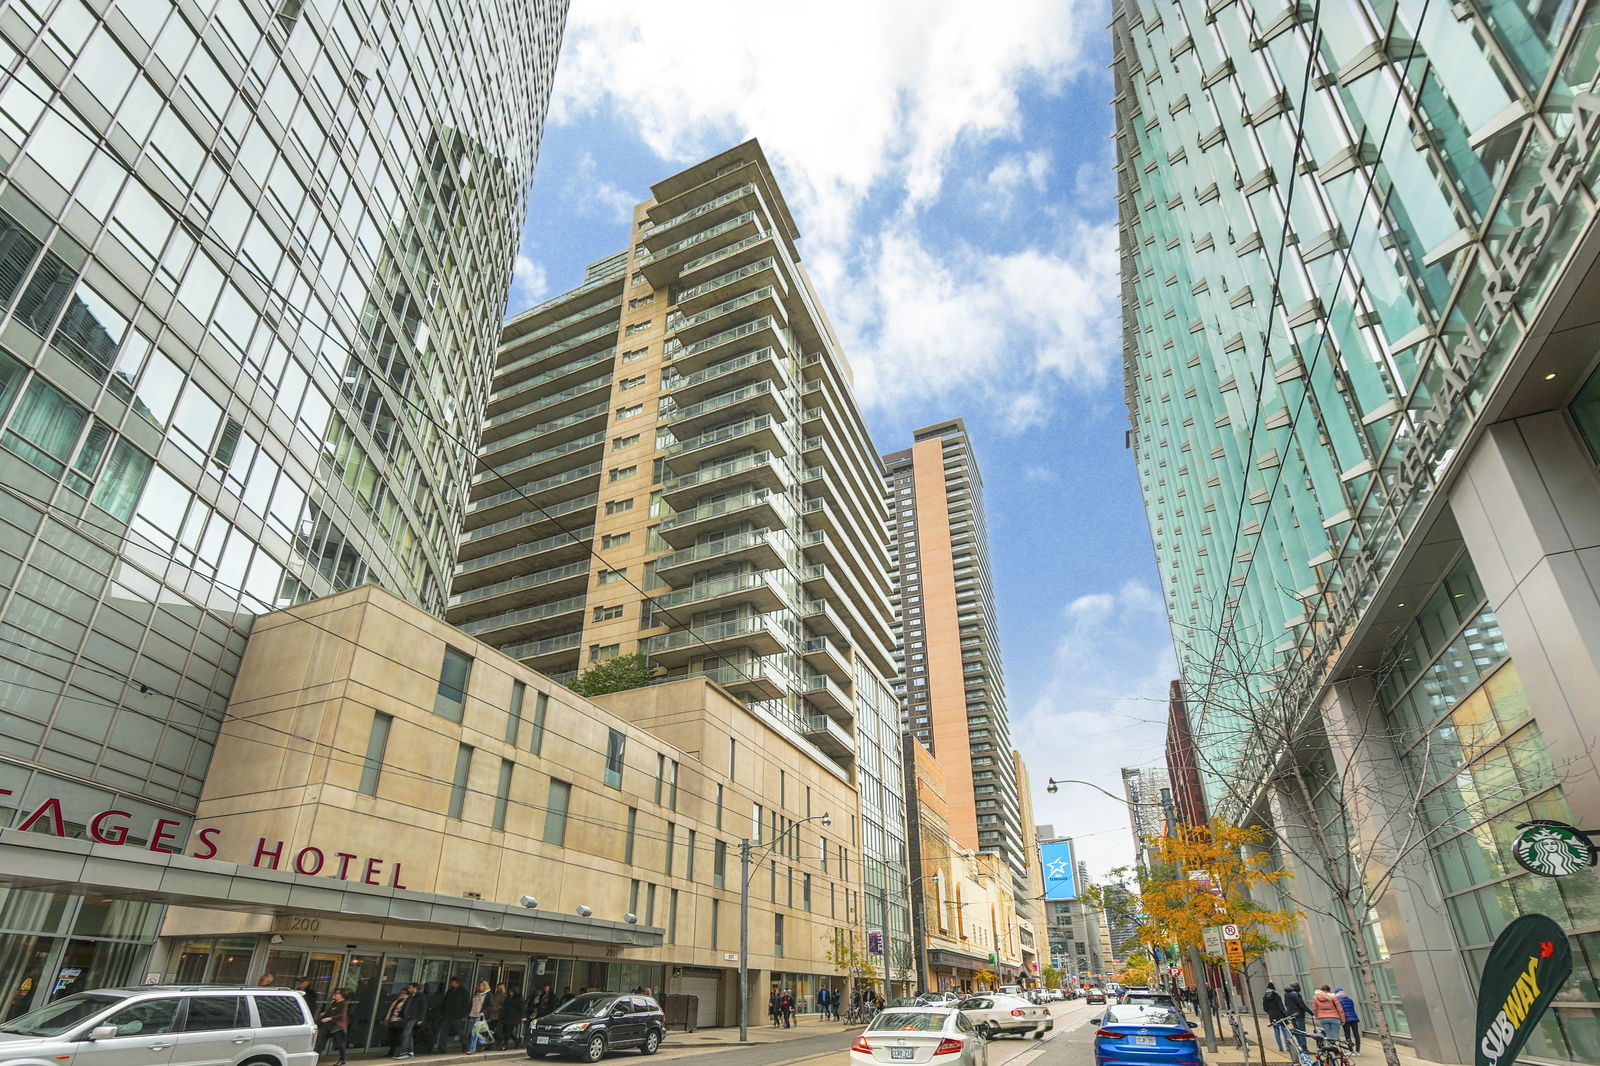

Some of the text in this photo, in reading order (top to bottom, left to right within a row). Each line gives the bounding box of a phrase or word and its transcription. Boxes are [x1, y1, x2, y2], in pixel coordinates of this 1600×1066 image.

[1395, 48, 1600, 502] KEENAN RESEA
[0, 789, 407, 890] AGES HOTEL
[290, 917, 320, 931] 200
[1481, 955, 1542, 1066] SUBWAY
